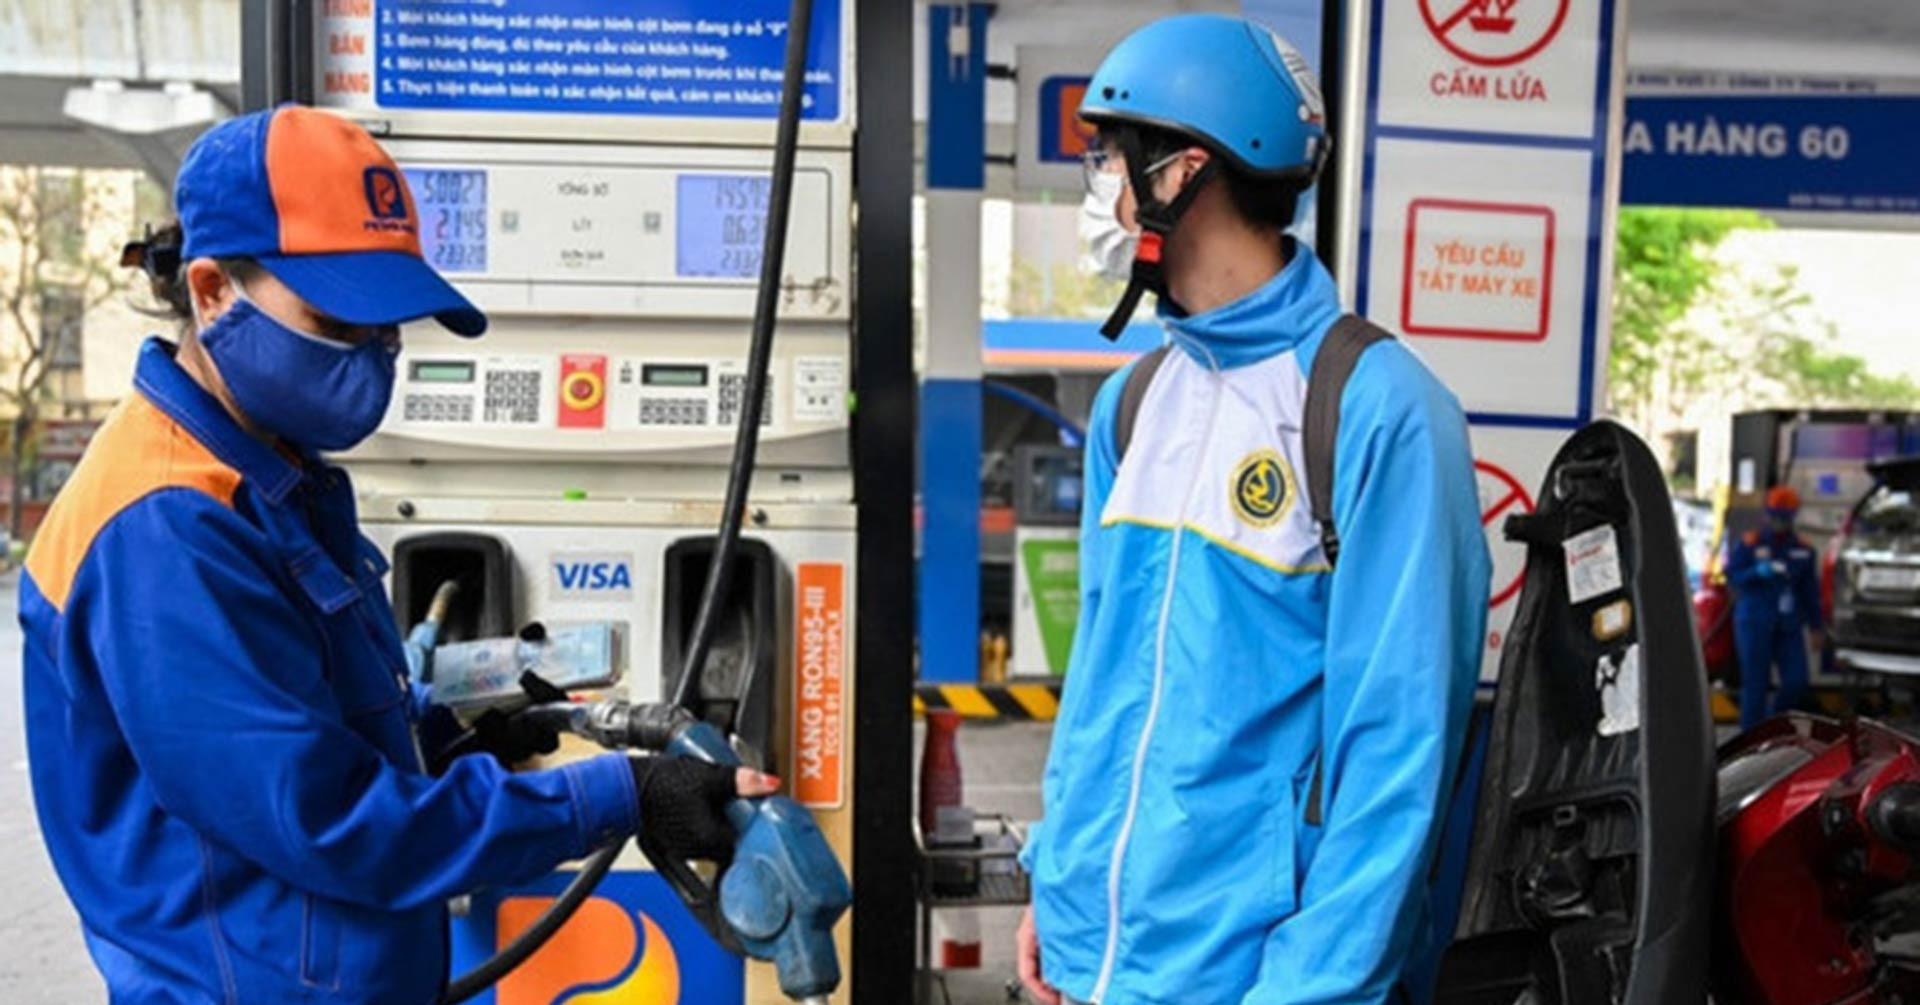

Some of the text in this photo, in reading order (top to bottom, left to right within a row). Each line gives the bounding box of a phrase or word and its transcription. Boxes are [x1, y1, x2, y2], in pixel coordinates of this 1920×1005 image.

[1430, 67, 1546, 100] CẤM LỬA
[1666, 116, 1787, 158] HÀNG
[1799, 125, 1850, 159] 60
[1434, 239, 1525, 269] YÊU CẦU
[1418, 268, 1537, 298] TẮT MÁY XE
[555, 563, 632, 589] VISA
